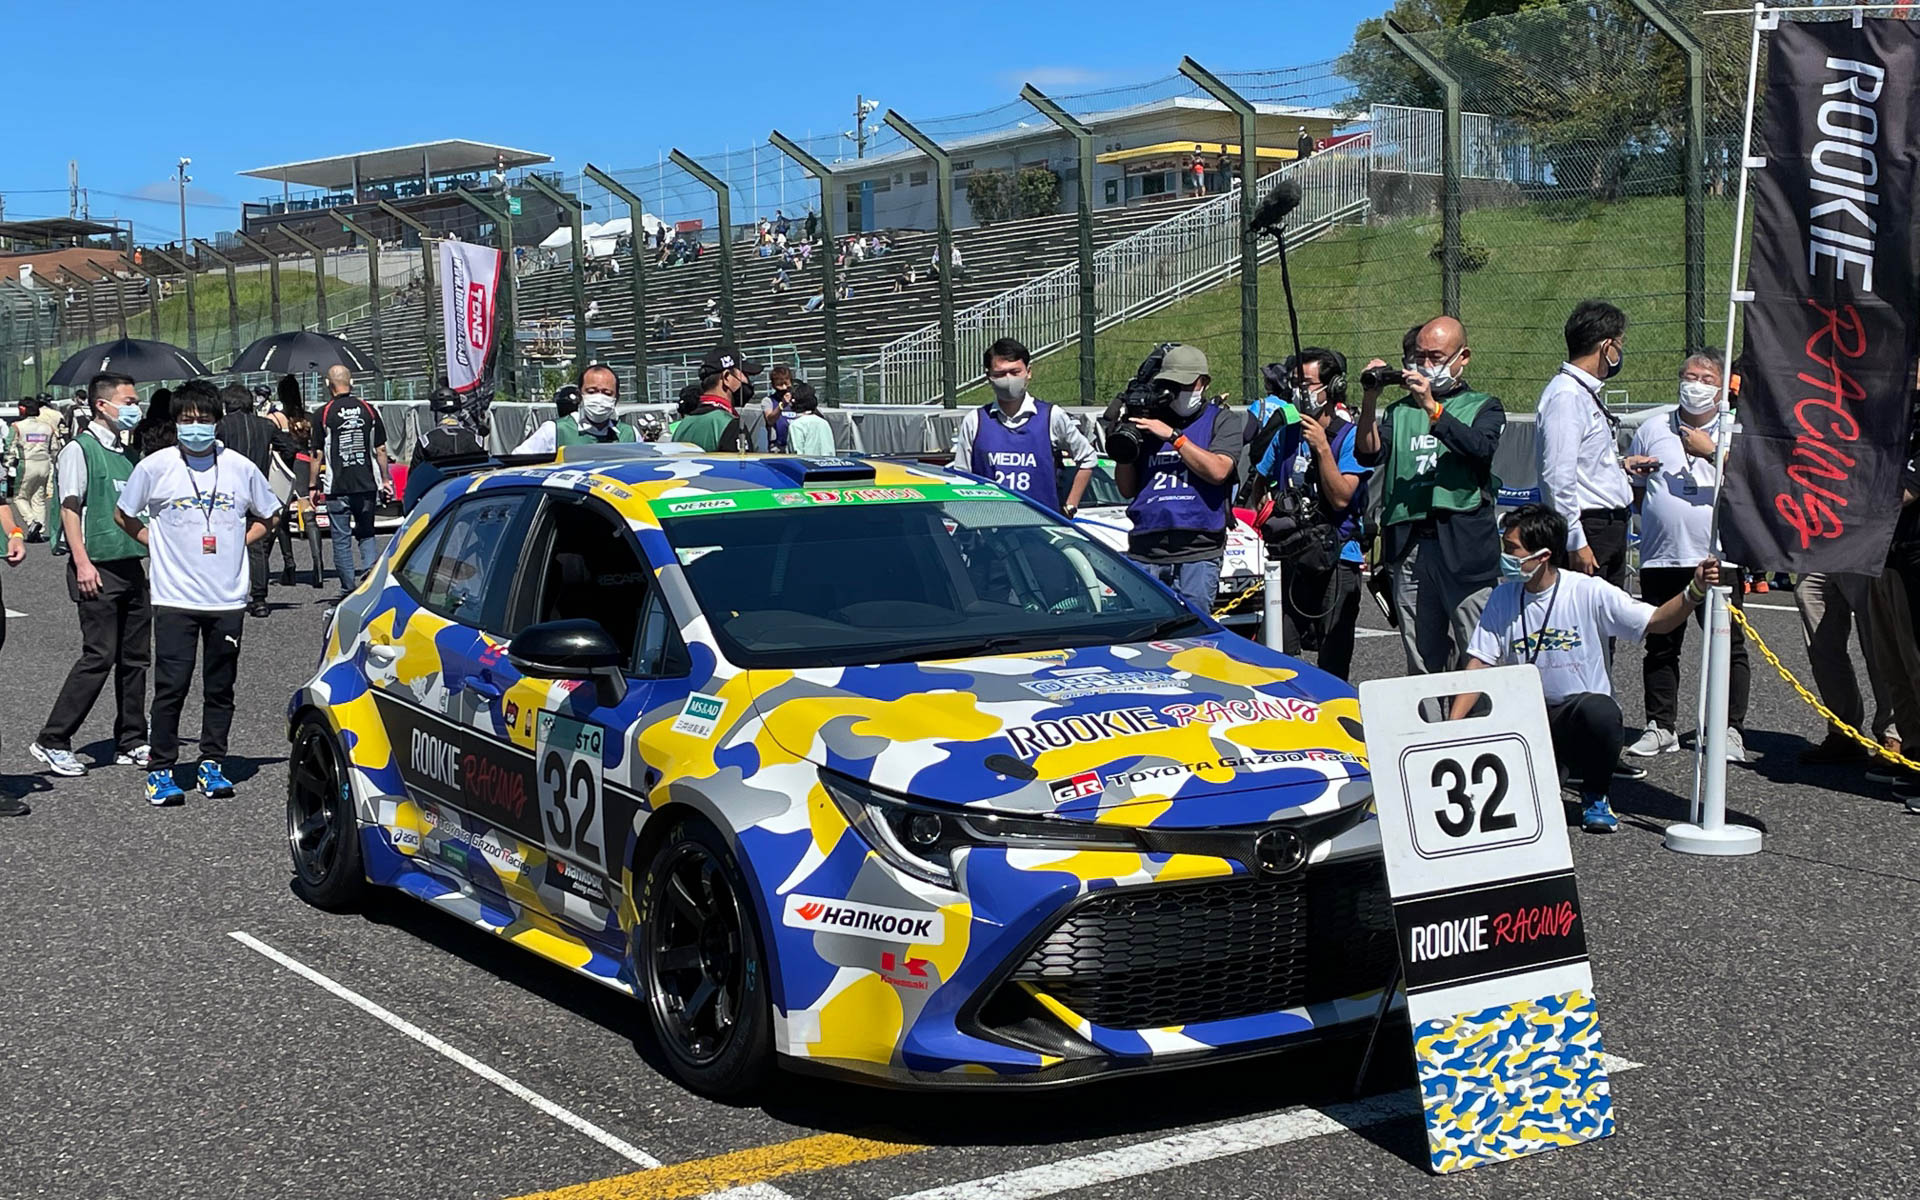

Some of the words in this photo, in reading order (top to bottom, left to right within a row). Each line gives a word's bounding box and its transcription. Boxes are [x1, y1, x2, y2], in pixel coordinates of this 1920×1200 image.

[1810, 56, 1885, 292] ROOKIE
[470, 287, 484, 347] TONE
[1775, 299, 1867, 549] RACING
[987, 452, 1037, 468] MEDIA
[995, 471, 1031, 491] 218
[690, 700, 719, 716] MS&AD
[1007, 708, 1165, 758] ROOKIE
[1165, 697, 1319, 727] RACING
[411, 728, 462, 791] ROOKIE
[463, 755, 528, 819] RACING
[1054, 777, 1103, 801] GR
[1108, 760, 1213, 785] TOYOTA
[1219, 751, 1303, 768] GAZOO
[1308, 749, 1368, 765] Racin
[1431, 752, 1518, 838] 32
[545, 751, 601, 868] 32
[471, 833, 501, 858] GAZOO
[501, 847, 531, 877] Racing
[1410, 914, 1489, 963] ROOKIE
[1492, 900, 1577, 946] RACING
[880, 974, 928, 990] Kawasaki
